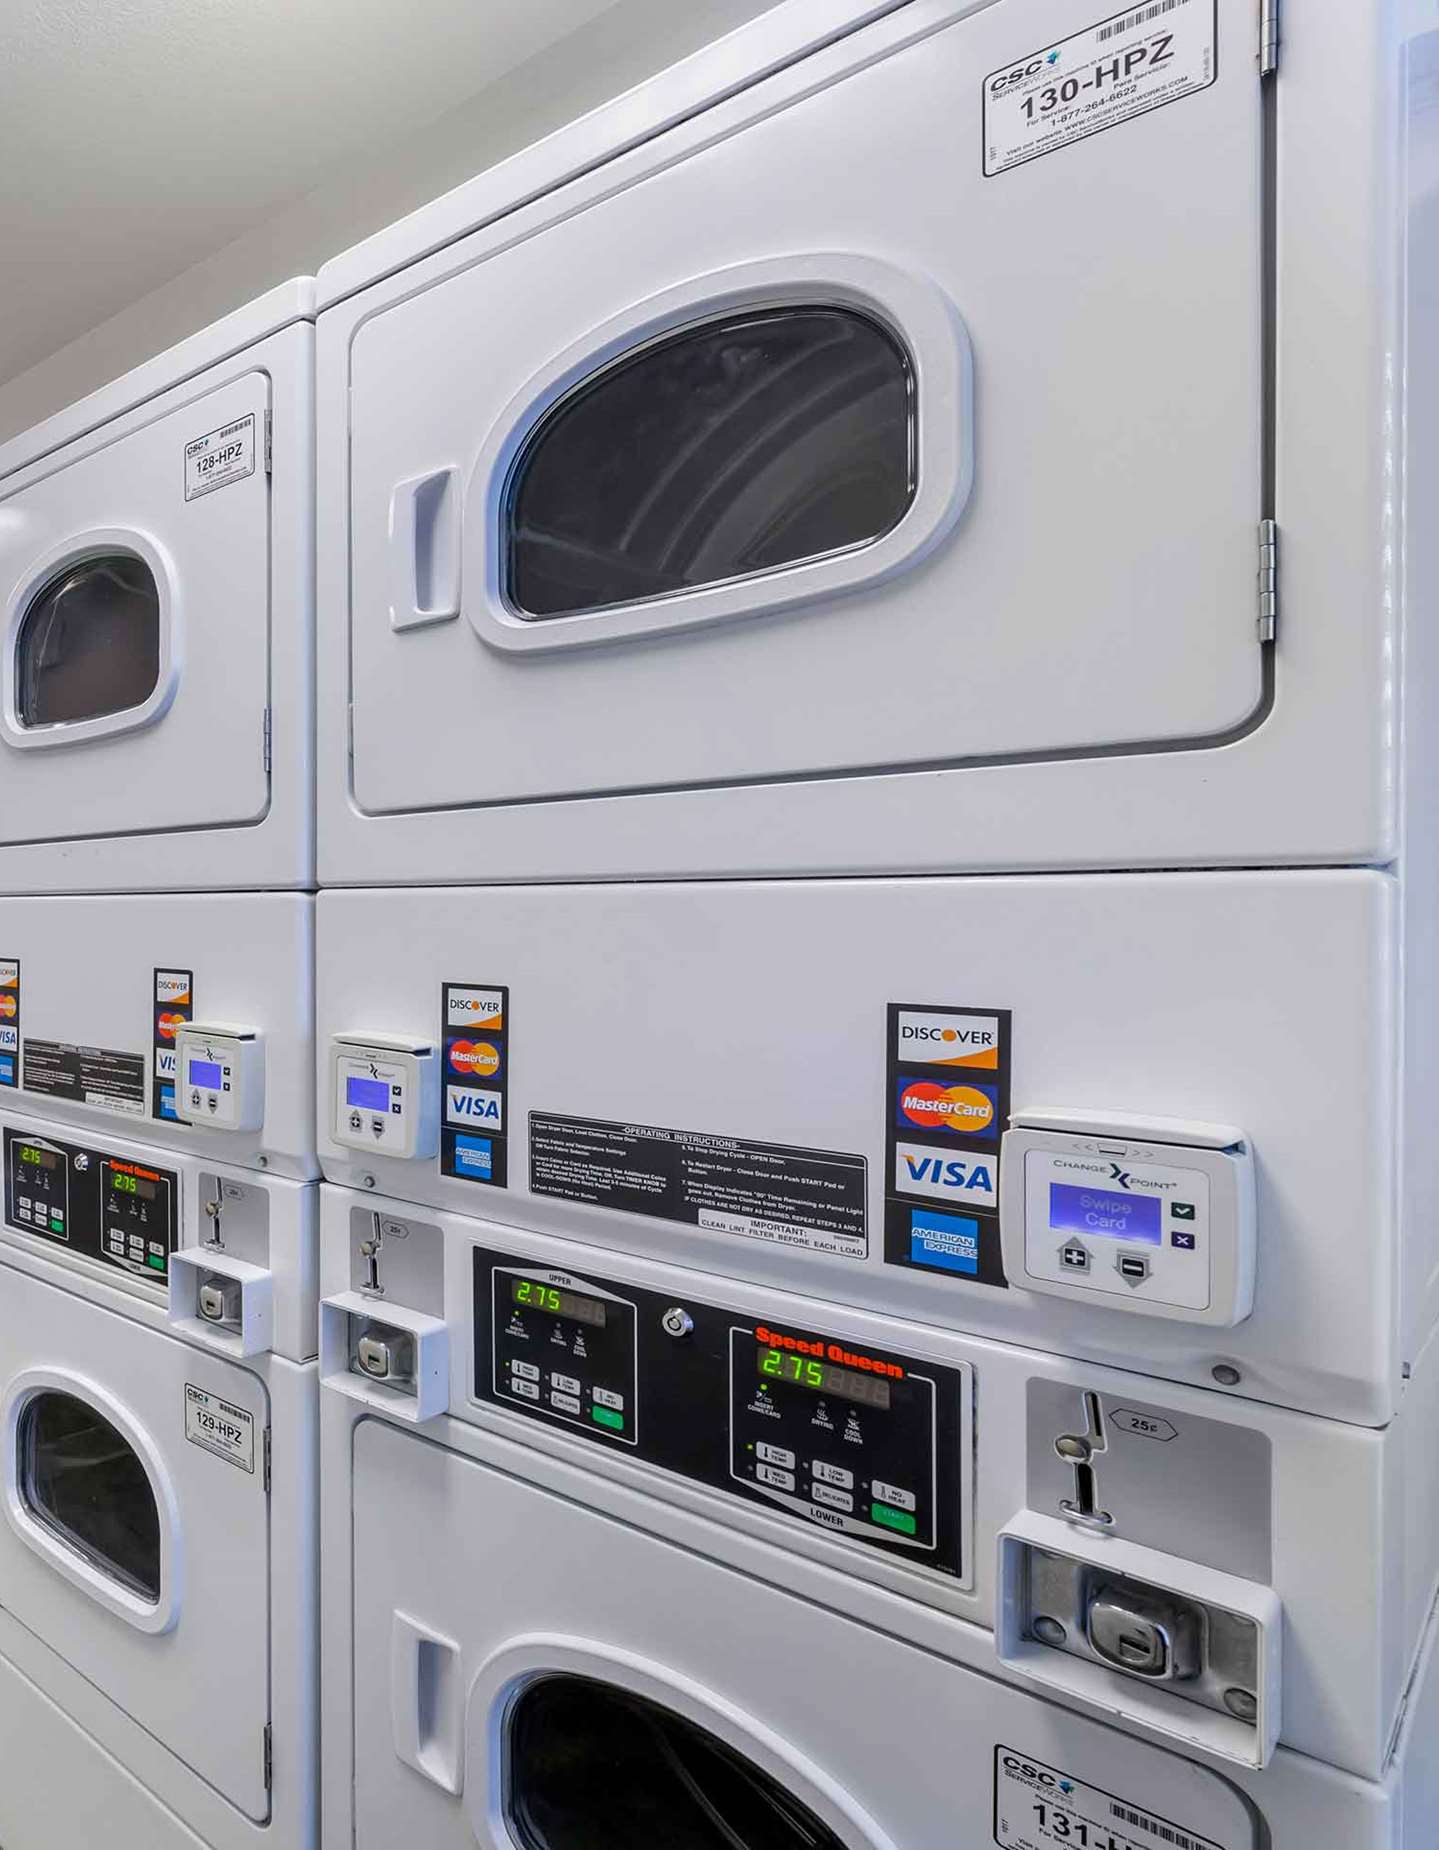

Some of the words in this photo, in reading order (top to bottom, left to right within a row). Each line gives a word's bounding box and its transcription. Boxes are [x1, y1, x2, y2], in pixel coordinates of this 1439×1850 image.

[991, 60, 1042, 92] CSC
[1020, 33, 1174, 122] 130-HPZ
[1051, 83, 1136, 126] 1-877-264-6622
[197, 442, 242, 473] 128-HPZ
[450, 999, 499, 1013] DISCOVER
[902, 1025, 992, 1045] DISCOVER
[160, 1056, 176, 1071] VI
[450, 1051, 498, 1066] MasterCard
[451, 1092, 499, 1119] VISA
[903, 1096, 992, 1120] MasterCard
[903, 1154, 993, 1192] VISA
[1053, 1160, 1108, 1173] CHANGE
[1080, 1195, 1132, 1214] Swipe
[750, 1219, 806, 1237] IMPORTANT:
[1086, 1212, 1126, 1230] Card
[701, 1219, 725, 1229] CLEAN
[729, 1224, 744, 1233] LINT
[749, 1228, 774, 1238] FILTER
[778, 1234, 809, 1245] BEFORE
[815, 1241, 836, 1251] EACH
[841, 1245, 863, 1256] LOAD
[912, 1227, 973, 1247] AMERICAN
[924, 1240, 977, 1259] EXPRESS
[549, 1274, 571, 1285] UPPER
[517, 1282, 560, 1310] 2.75
[755, 1326, 825, 1358] Speed
[828, 1345, 904, 1379] Queen
[763, 1350, 822, 1386] 2.75
[197, 1411, 242, 1445] 129-HPZ
[845, 1428, 860, 1438] COOL
[844, 1434, 863, 1444] DOWN
[891, 1490, 902, 1498] NO
[810, 1507, 843, 1526] LOWER
[1003, 1754, 1055, 1788] CSC
